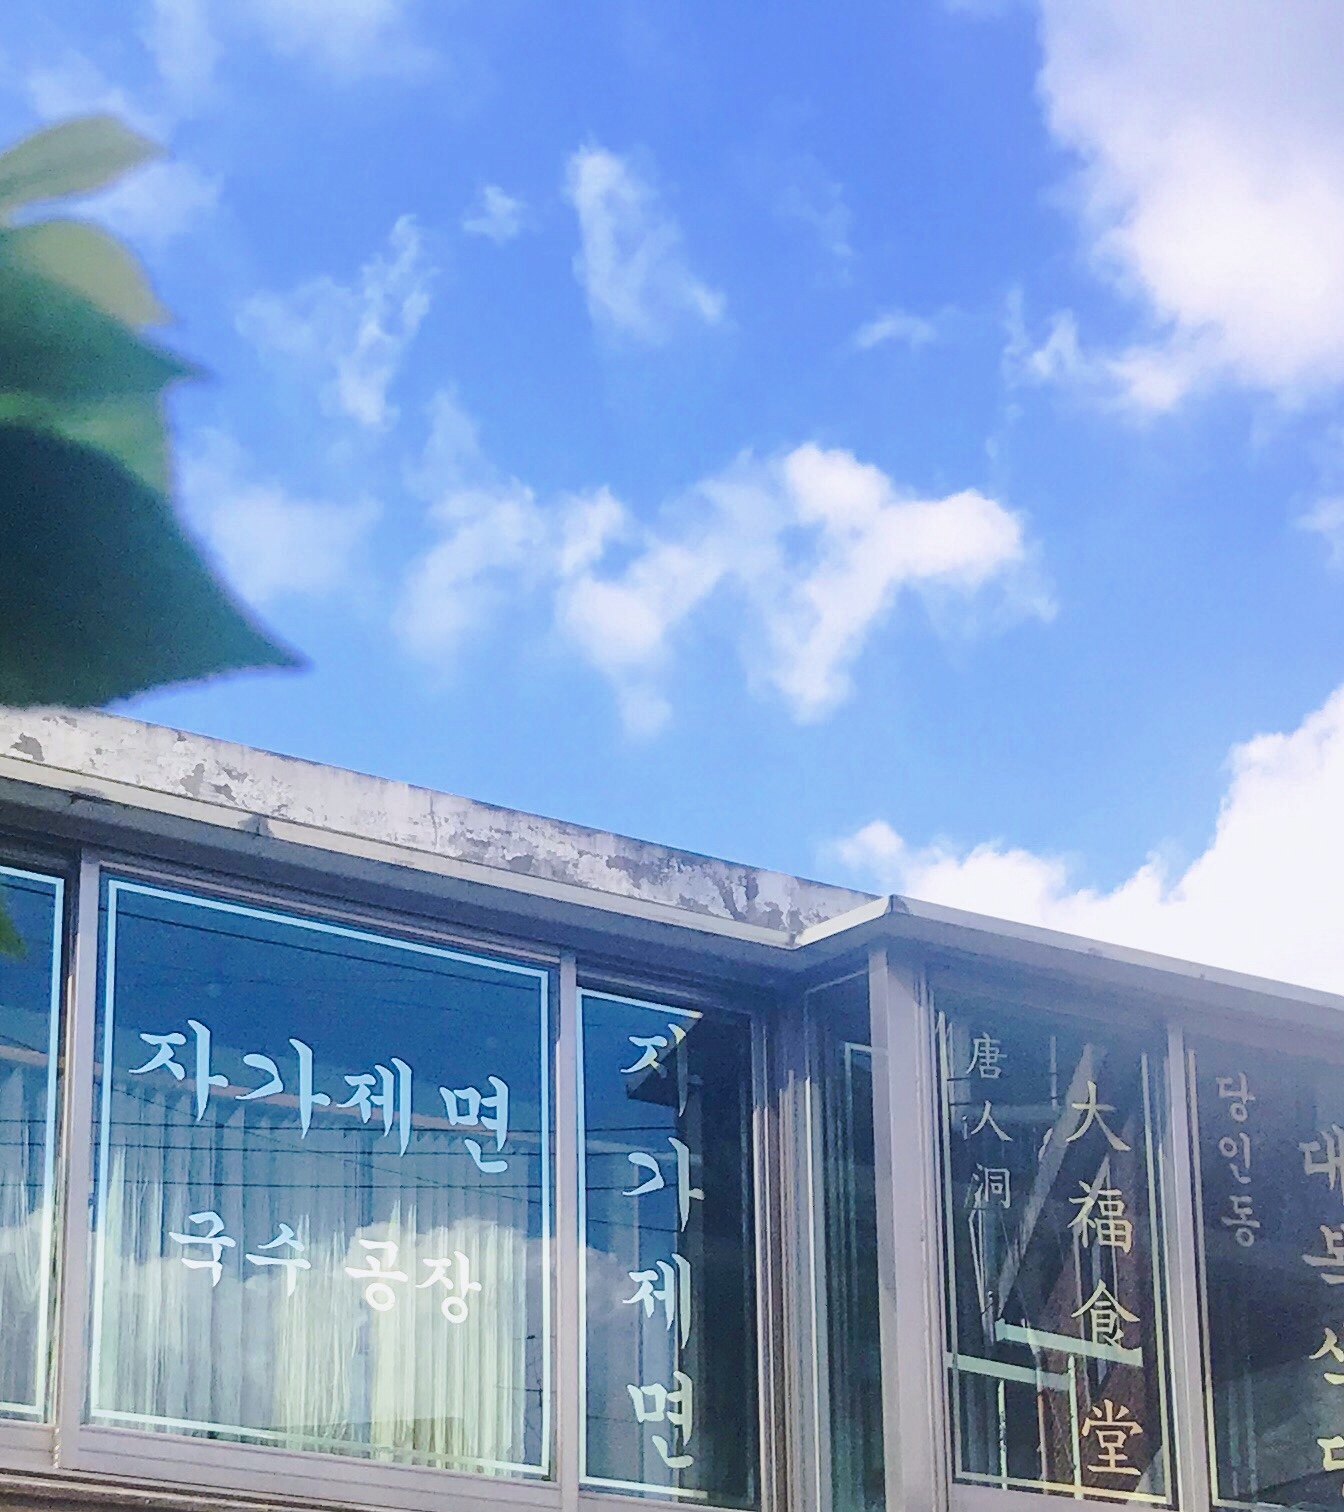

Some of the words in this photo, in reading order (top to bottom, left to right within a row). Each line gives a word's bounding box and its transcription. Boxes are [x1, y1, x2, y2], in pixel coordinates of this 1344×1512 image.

[128, 1019, 509, 1174] 자가제면
[964, 1032, 1014, 1209] 唐人洞
[1215, 1072, 1261, 1248] 당인동
[168, 1211, 312, 1298] 국수
[344, 1238, 483, 1325] 공장
[619, 1022, 706, 1470] 자가제면
[1065, 1079, 1144, 1477] 大福食堂
